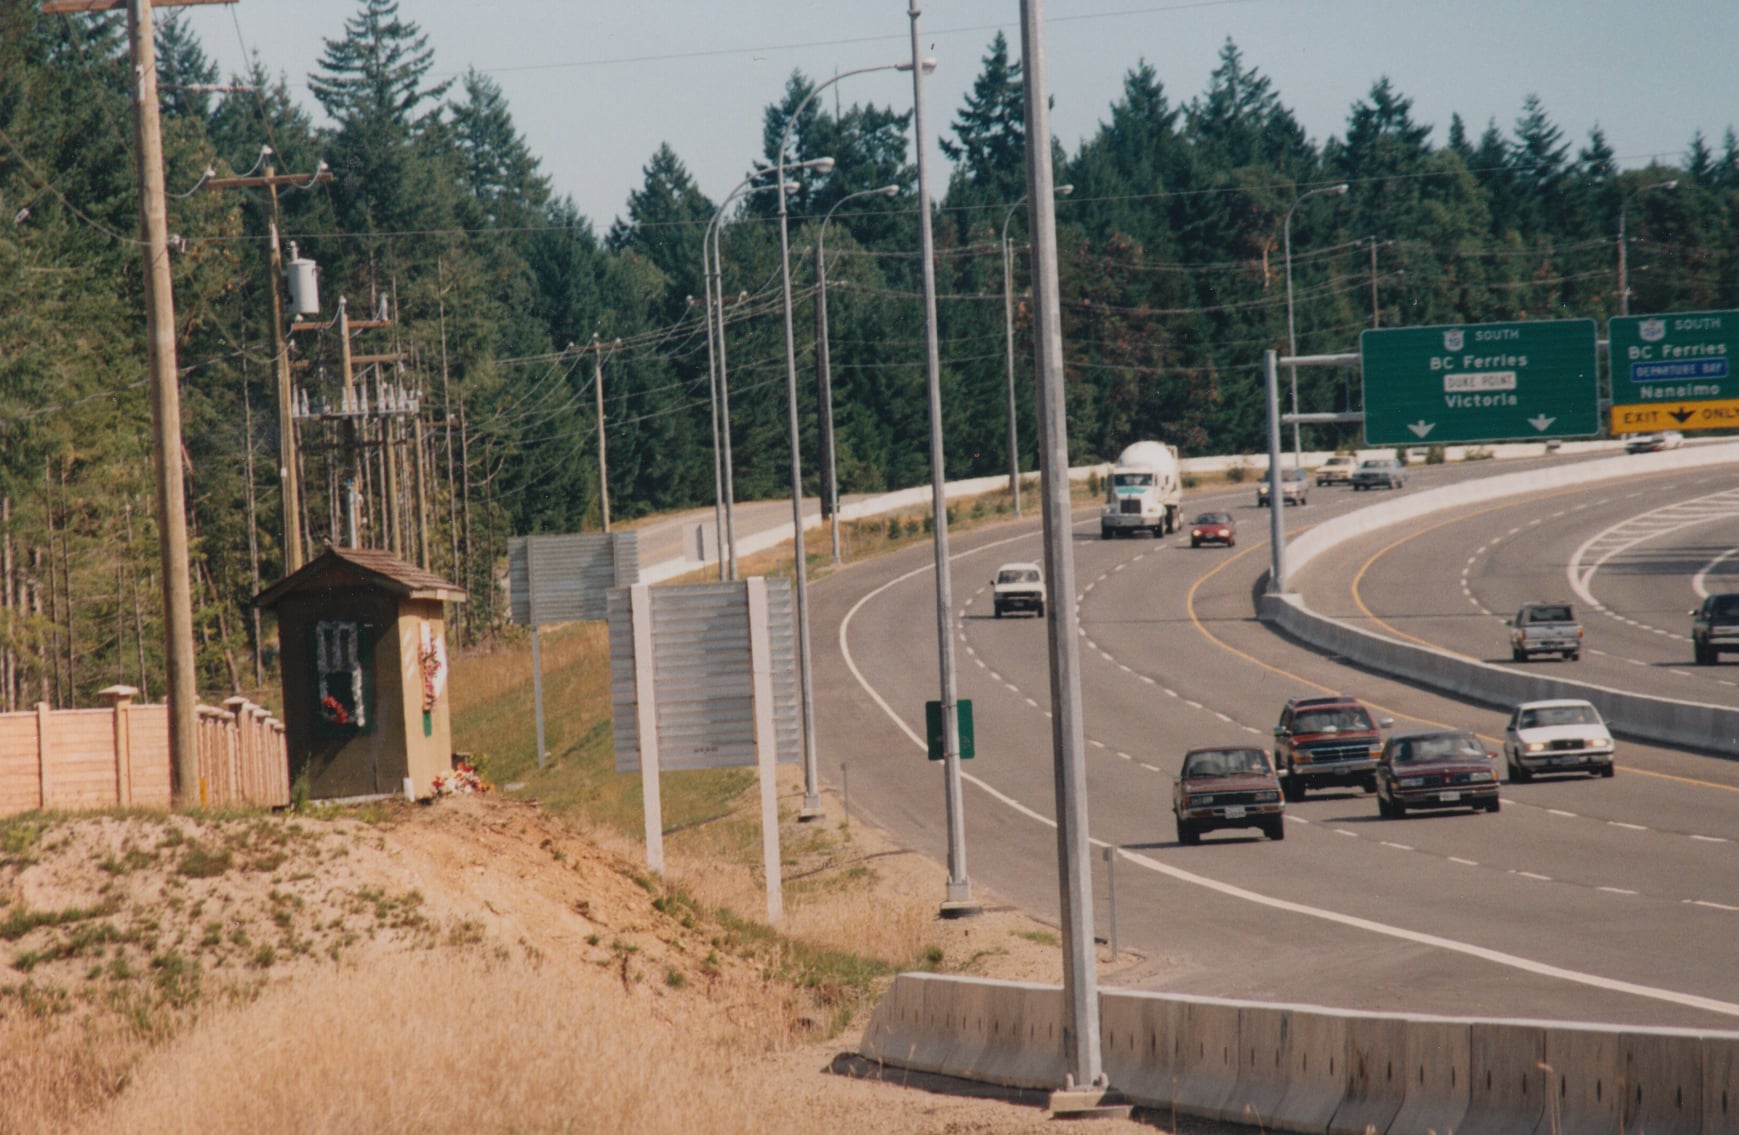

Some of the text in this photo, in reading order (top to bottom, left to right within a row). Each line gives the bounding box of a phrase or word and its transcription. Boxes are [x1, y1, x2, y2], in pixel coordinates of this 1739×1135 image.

[1674, 318, 1720, 330] SOUTH
[1475, 329, 1519, 341] SOUTH
[1628, 343, 1726, 359] BC Ferries
[1430, 354, 1528, 370] BC Ferries
[1448, 374, 1512, 388] DUKE POINT
[1640, 384, 1720, 398] Nanaimo
[1445, 393, 1517, 408] Victoria
[1624, 411, 1658, 424] EXIT
